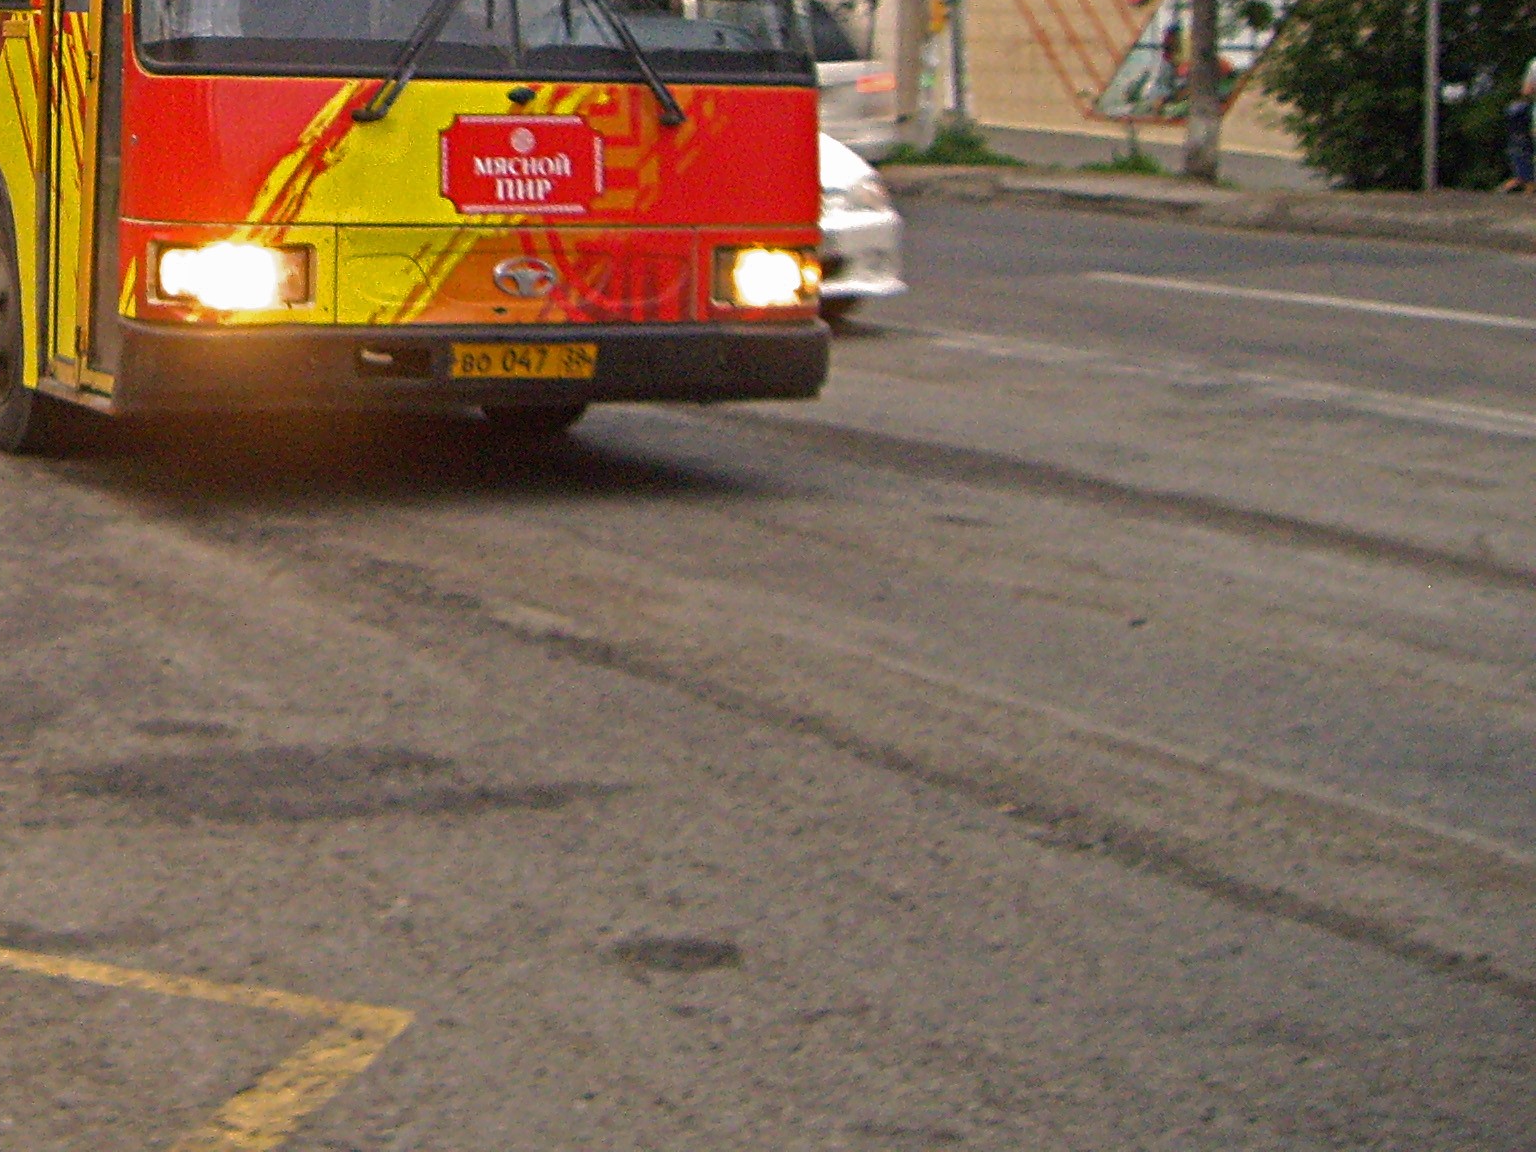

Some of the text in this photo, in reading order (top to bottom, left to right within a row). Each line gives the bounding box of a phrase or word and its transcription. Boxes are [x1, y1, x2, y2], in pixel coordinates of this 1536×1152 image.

[473, 153, 572, 177] МЯСНОЙ
[495, 177, 554, 201] ПИР
[502, 346, 550, 373] 047
